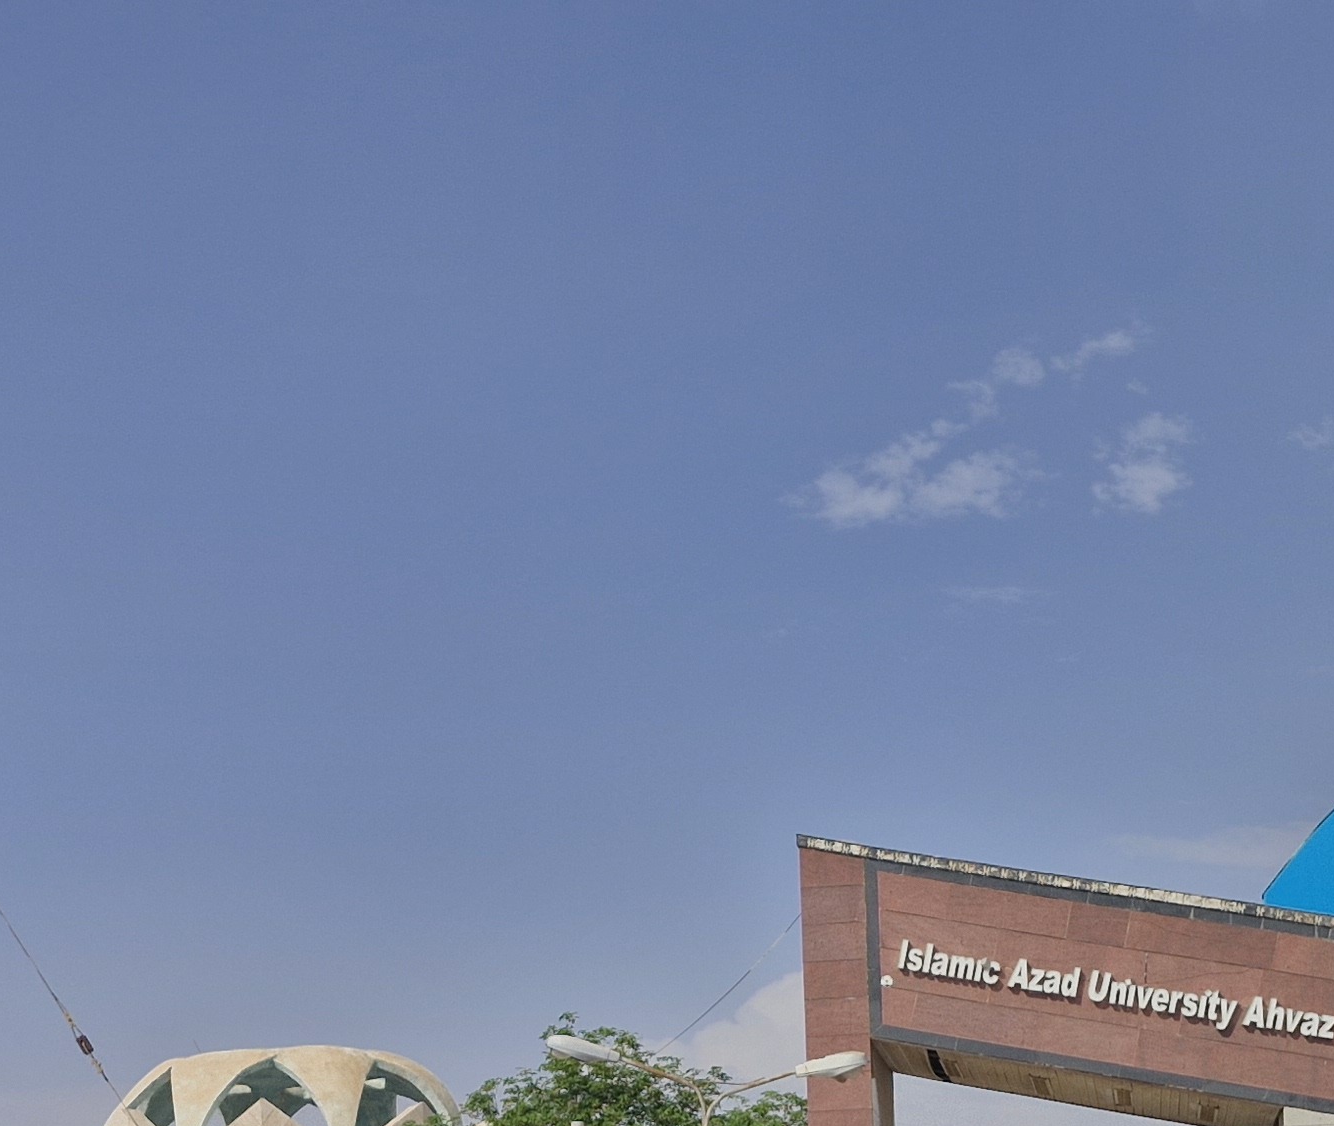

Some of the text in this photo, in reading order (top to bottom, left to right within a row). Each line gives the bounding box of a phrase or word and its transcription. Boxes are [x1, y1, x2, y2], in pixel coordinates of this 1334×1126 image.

[897, 939, 1001, 986] Islamic
[1008, 957, 1082, 999] Azad
[1087, 969, 1239, 1031] University
